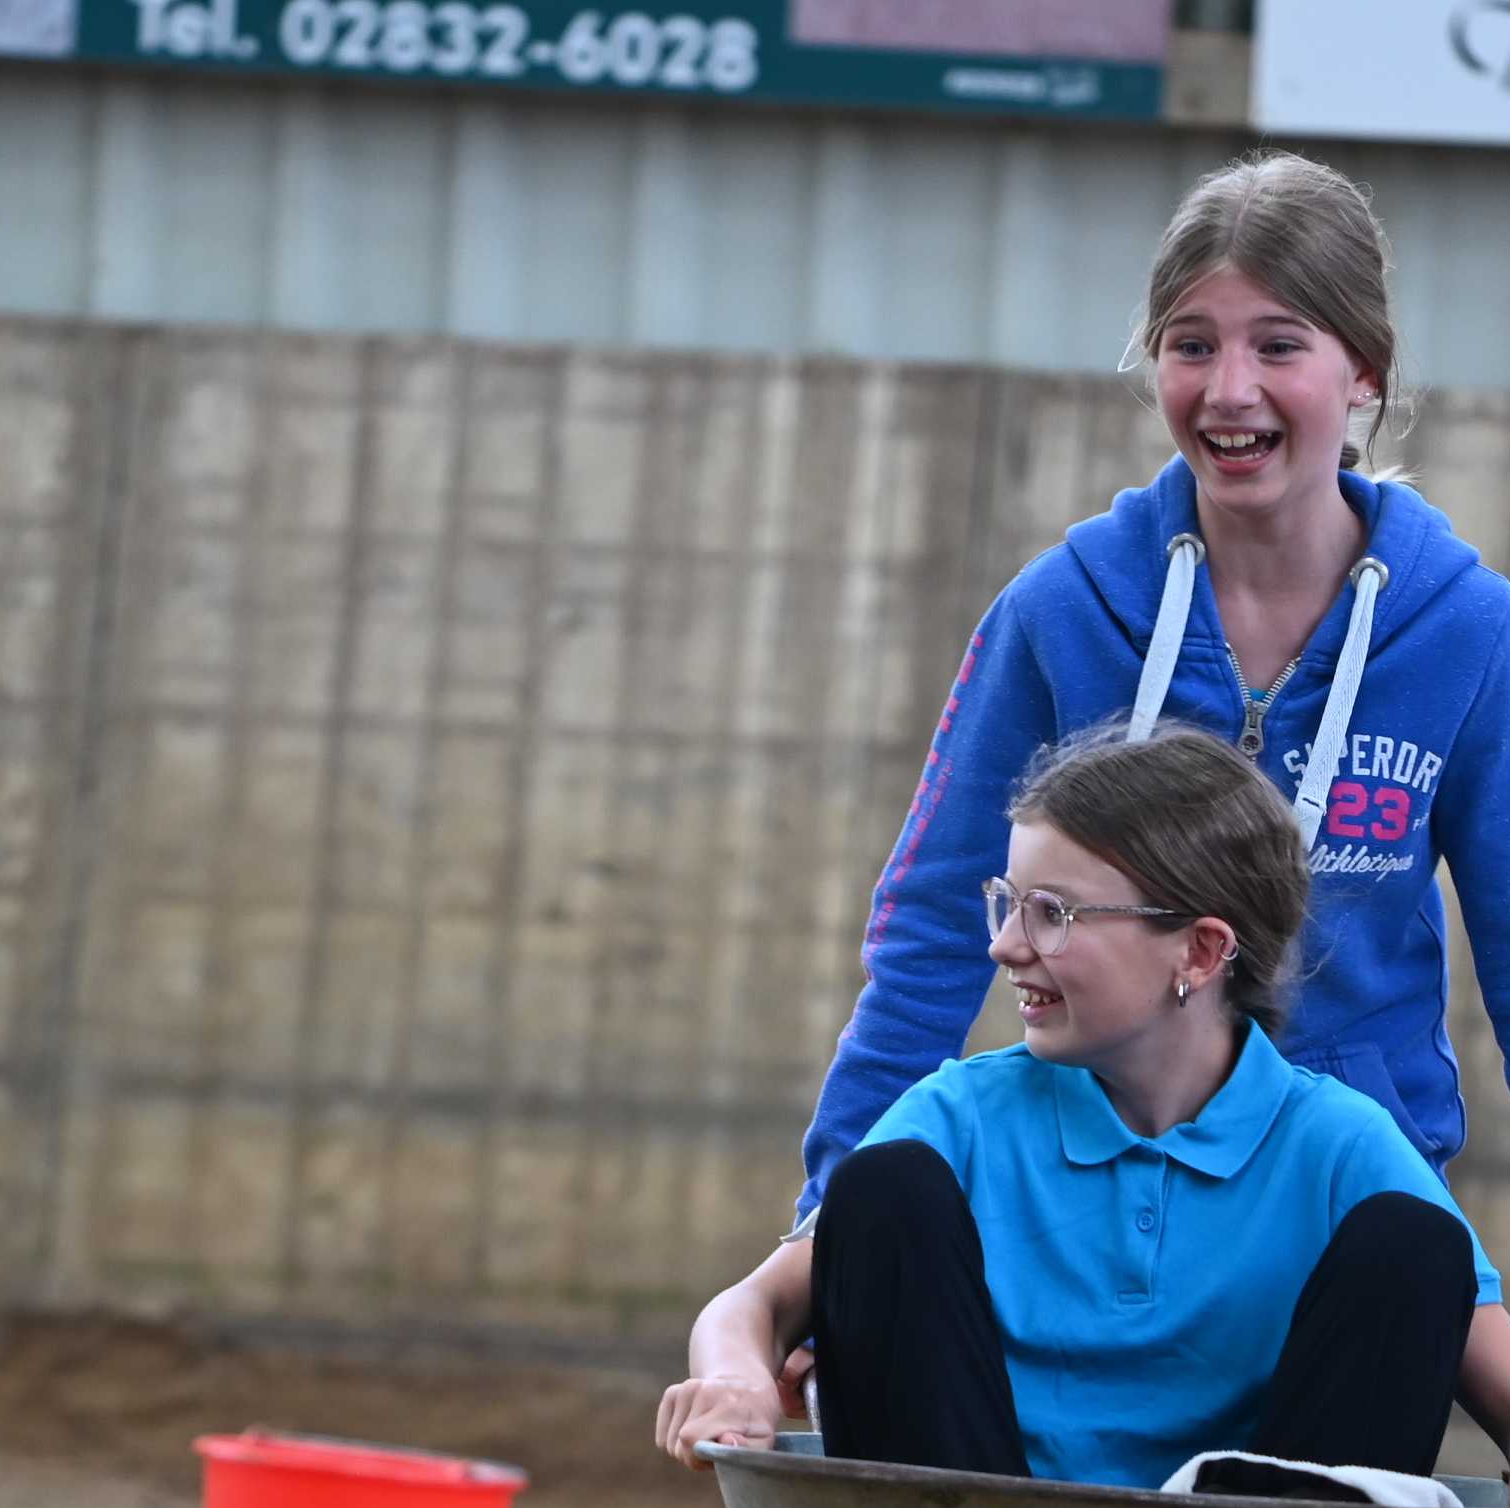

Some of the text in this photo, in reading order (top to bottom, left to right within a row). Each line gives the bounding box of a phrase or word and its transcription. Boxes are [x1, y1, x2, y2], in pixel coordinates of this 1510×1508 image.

[135, 0, 757, 92] Tel. 02832-6028
[1328, 781, 1410, 841] 23
